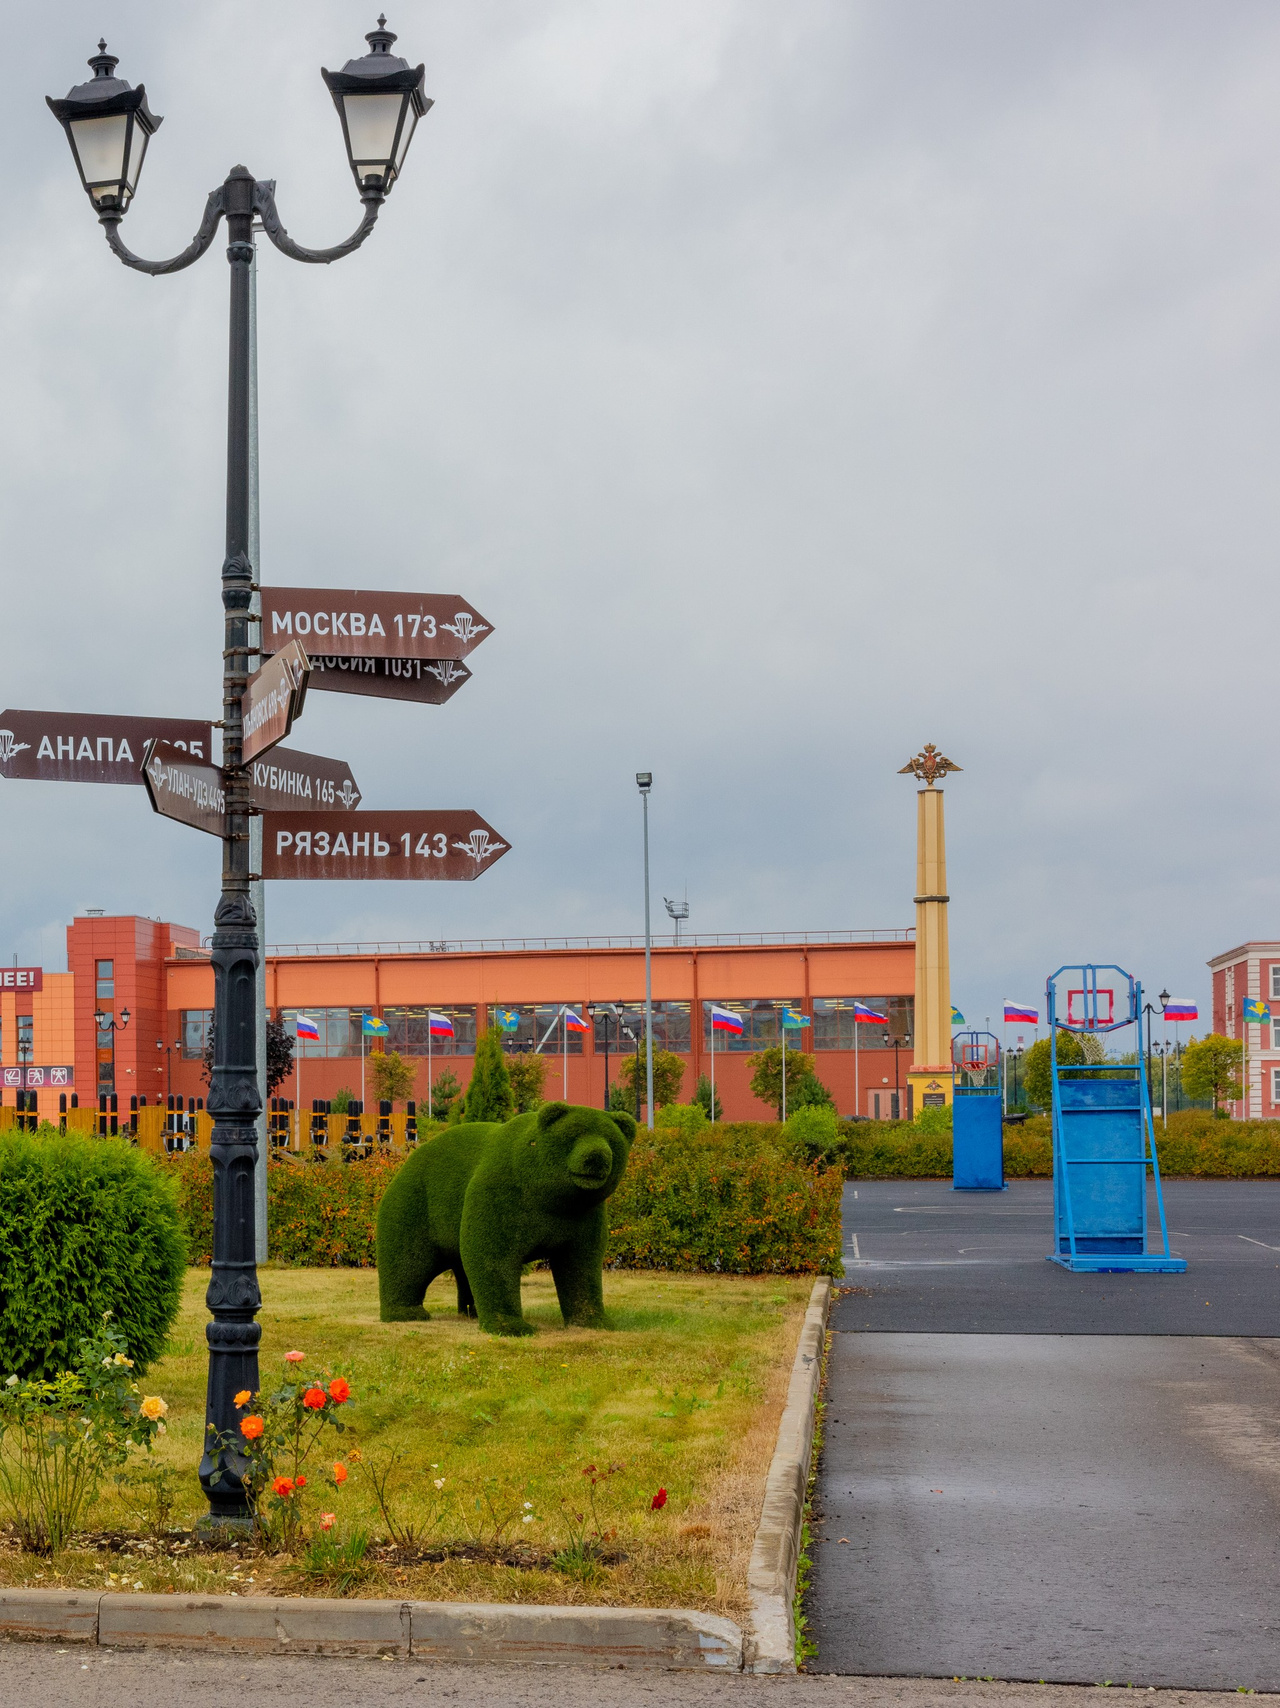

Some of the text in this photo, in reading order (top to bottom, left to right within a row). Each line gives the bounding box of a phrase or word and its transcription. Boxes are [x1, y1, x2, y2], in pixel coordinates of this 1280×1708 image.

[271, 611, 437, 638] МОСКВА 173
[36, 735, 135, 762] АНАПА
[166, 766, 209, 810] УЛАН-УДЭ
[253, 762, 335, 803] КУБИНКА 165
[276, 830, 448, 858] РЯЗАНЬ 143
